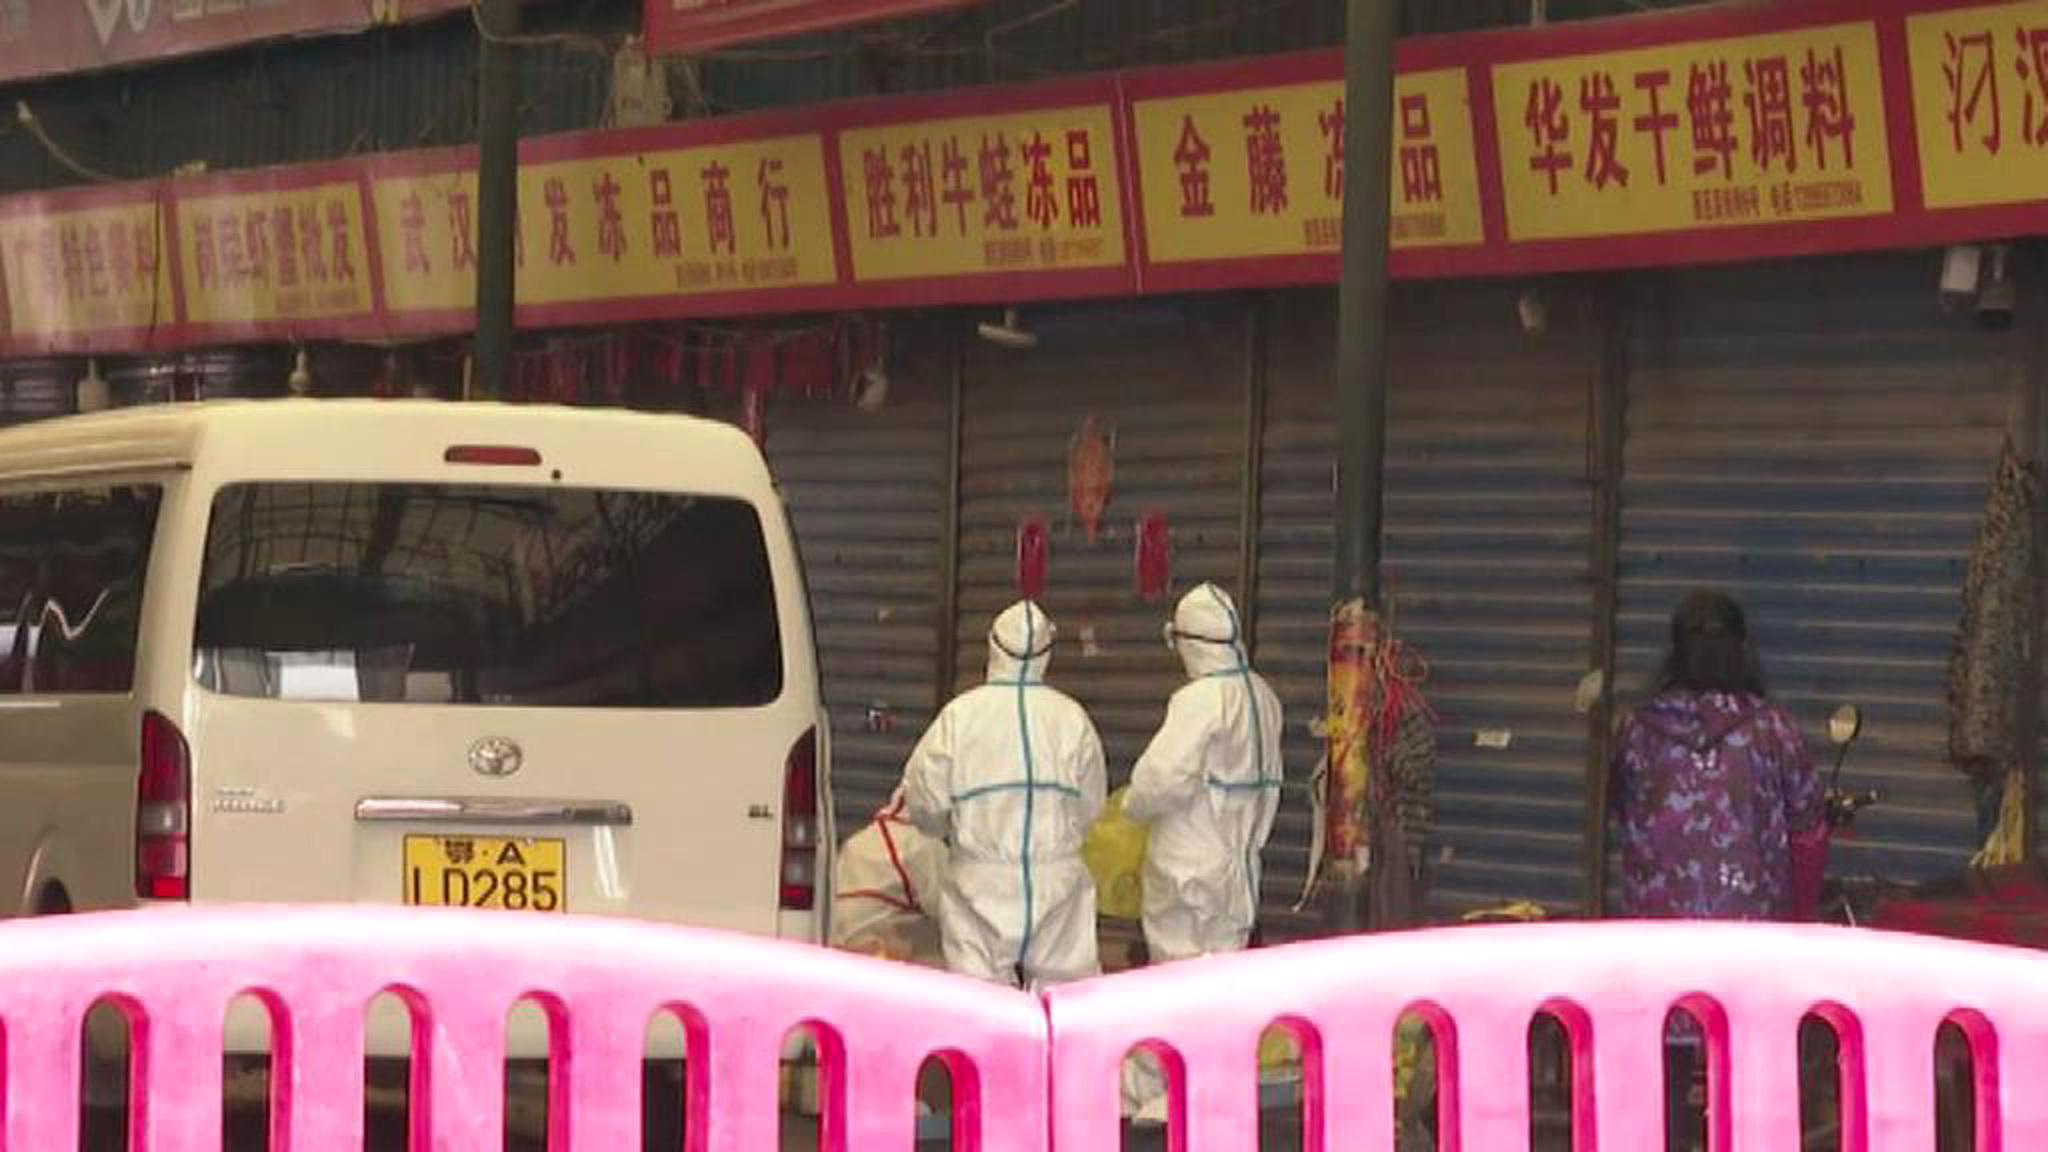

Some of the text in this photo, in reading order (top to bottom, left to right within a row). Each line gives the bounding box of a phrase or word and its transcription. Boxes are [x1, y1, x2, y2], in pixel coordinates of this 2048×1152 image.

[1525, 46, 1856, 196] 华发干鲜调料
[402, 157, 790, 276] 武汉发冻品商行
[863, 130, 1102, 239] 胜利牛蛙冻品
